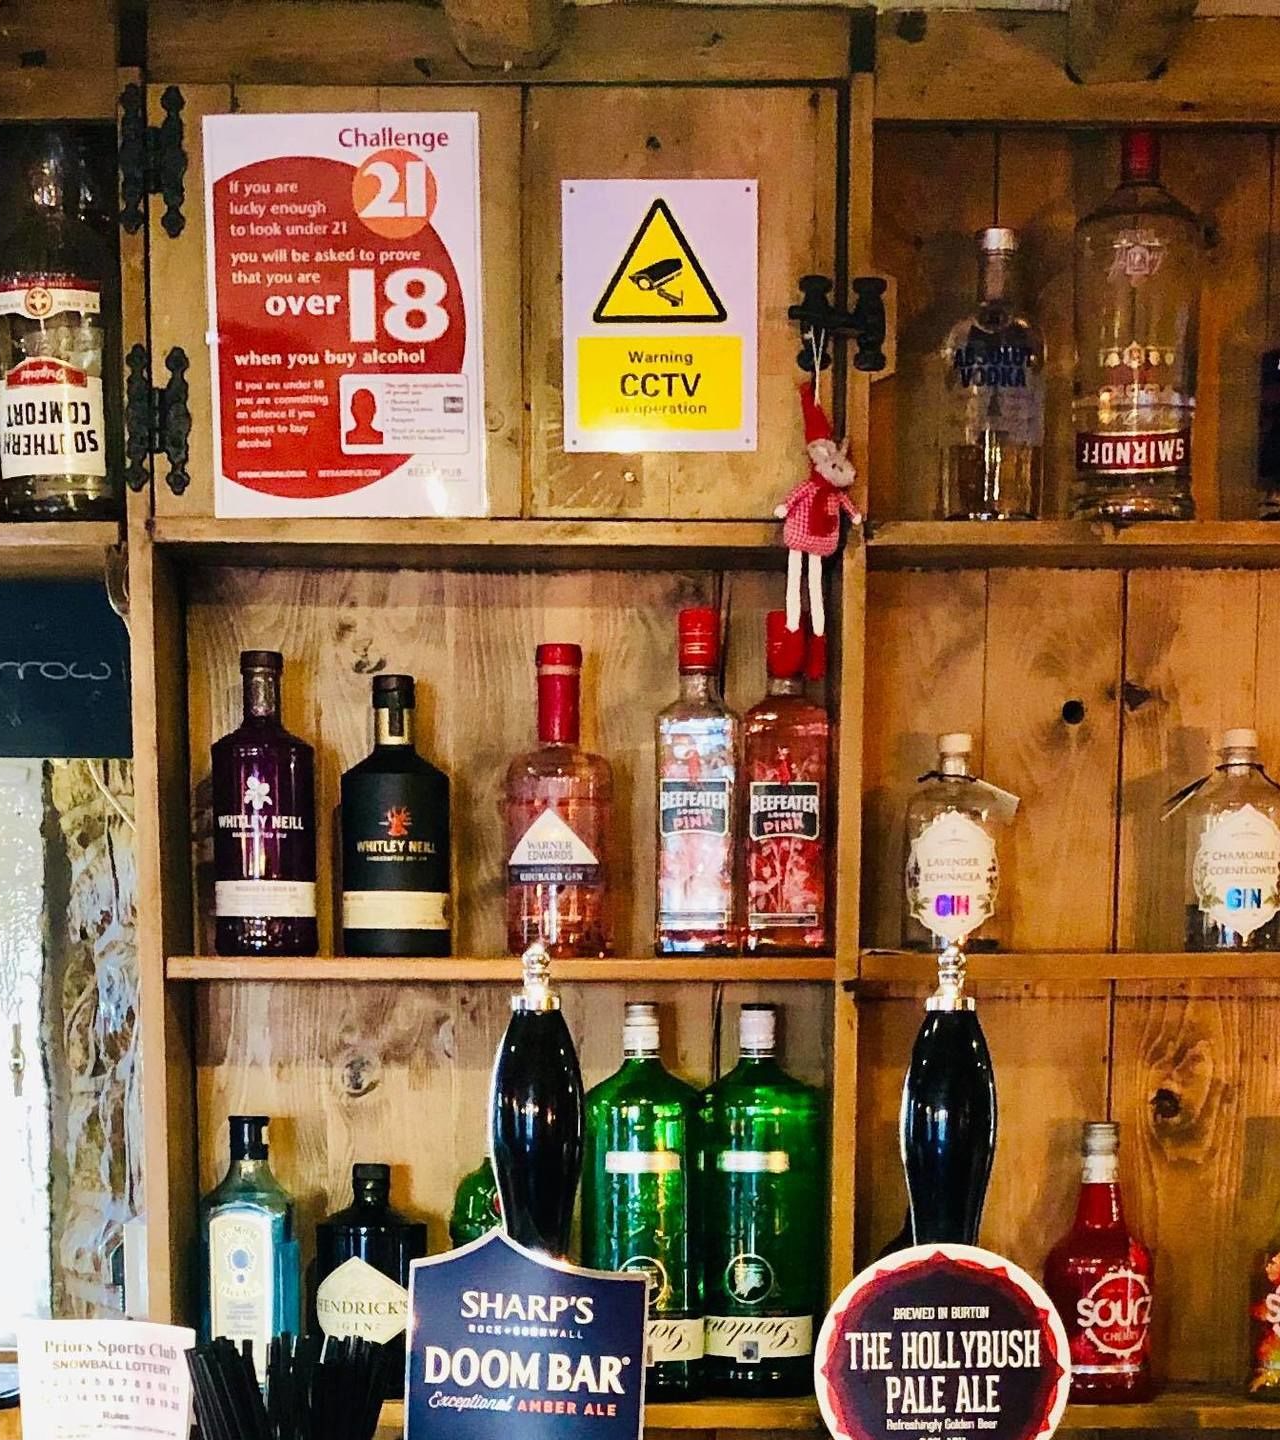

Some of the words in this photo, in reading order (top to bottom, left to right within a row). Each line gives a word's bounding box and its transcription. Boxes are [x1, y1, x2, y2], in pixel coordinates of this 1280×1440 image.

[338, 127, 449, 152] Challenge
[229, 181, 242, 193] If
[244, 183, 271, 197] you
[275, 183, 298, 194] are
[358, 161, 428, 218] 21
[230, 203, 265, 216] lucky
[270, 202, 326, 217] enough
[230, 224, 247, 237] to
[250, 222, 281, 235] look
[286, 222, 328, 235] under
[331, 222, 347, 234] 21
[231, 250, 258, 267] you
[262, 250, 287, 263] will
[291, 249, 310, 263] be
[314, 248, 356, 262] asked
[359, 249, 375, 261] to
[380, 250, 421, 267] prove
[232, 271, 262, 285] that
[265, 271, 294, 288] you
[297, 271, 320, 284] are
[265, 294, 341, 317] over
[349, 267, 450, 342] 18
[234, 351, 282, 366] when
[287, 351, 319, 369] you
[325, 349, 356, 368] buy
[362, 349, 425, 364] alcohol
[628, 350, 693, 366] Warning
[620, 373, 702, 398] CCTV
[7, 401, 90, 426] COMFORT
[1082, 438, 1184, 464] SMIRNOFF
[660, 791, 728, 810] BEEFEATER
[750, 795, 819, 812] BEEFEATER
[218, 815, 268, 830] WHITLEY
[272, 815, 304, 830] NEILL
[673, 813, 713, 830] PINK
[762, 818, 803, 834] PINK
[357, 840, 406, 853] WHITLEY
[409, 840, 436, 853] NEILL
[527, 851, 573, 861] EDWARDS
[927, 857, 980, 867] LAVENDER
[1211, 850, 1276, 862] CHAMOMILE
[924, 872, 982, 882] ECHINACEA
[935, 894, 970, 917] GIN
[1225, 887, 1262, 910] GIN
[318, 1302, 409, 1316] HENDRICK'S
[461, 1291, 594, 1325] SHARP'S
[893, 1307, 935, 1320] BREWED
[938, 1307, 948, 1319] IN
[951, 1306, 989, 1319] BURTON
[341, 1323, 372, 1332] GIN
[468, 1323, 502, 1335] ROCK
[513, 1325, 583, 1339] CORNWALL
[45, 1341, 92, 1353] Priors
[97, 1341, 146, 1356] Sports
[150, 1343, 177, 1360] Club
[844, 1332, 892, 1370] THE
[902, 1329, 1040, 1370] HOLLYBUSH
[53, 1360, 123, 1370] SNOWBALL
[126, 1361, 172, 1376] LOTTERY
[424, 1346, 540, 1390] DOOM
[548, 1353, 625, 1394] BAR
[886, 1376, 946, 1414] PALE
[955, 1375, 1001, 1413] ALE
[428, 1391, 514, 1412] Exceptional
[516, 1400, 577, 1415] AMBER
[584, 1403, 616, 1417] ALE
[886, 1418, 943, 1433] Refreshingly
[944, 1418, 974, 1430] Golden
[978, 1418, 997, 1430] Beer
